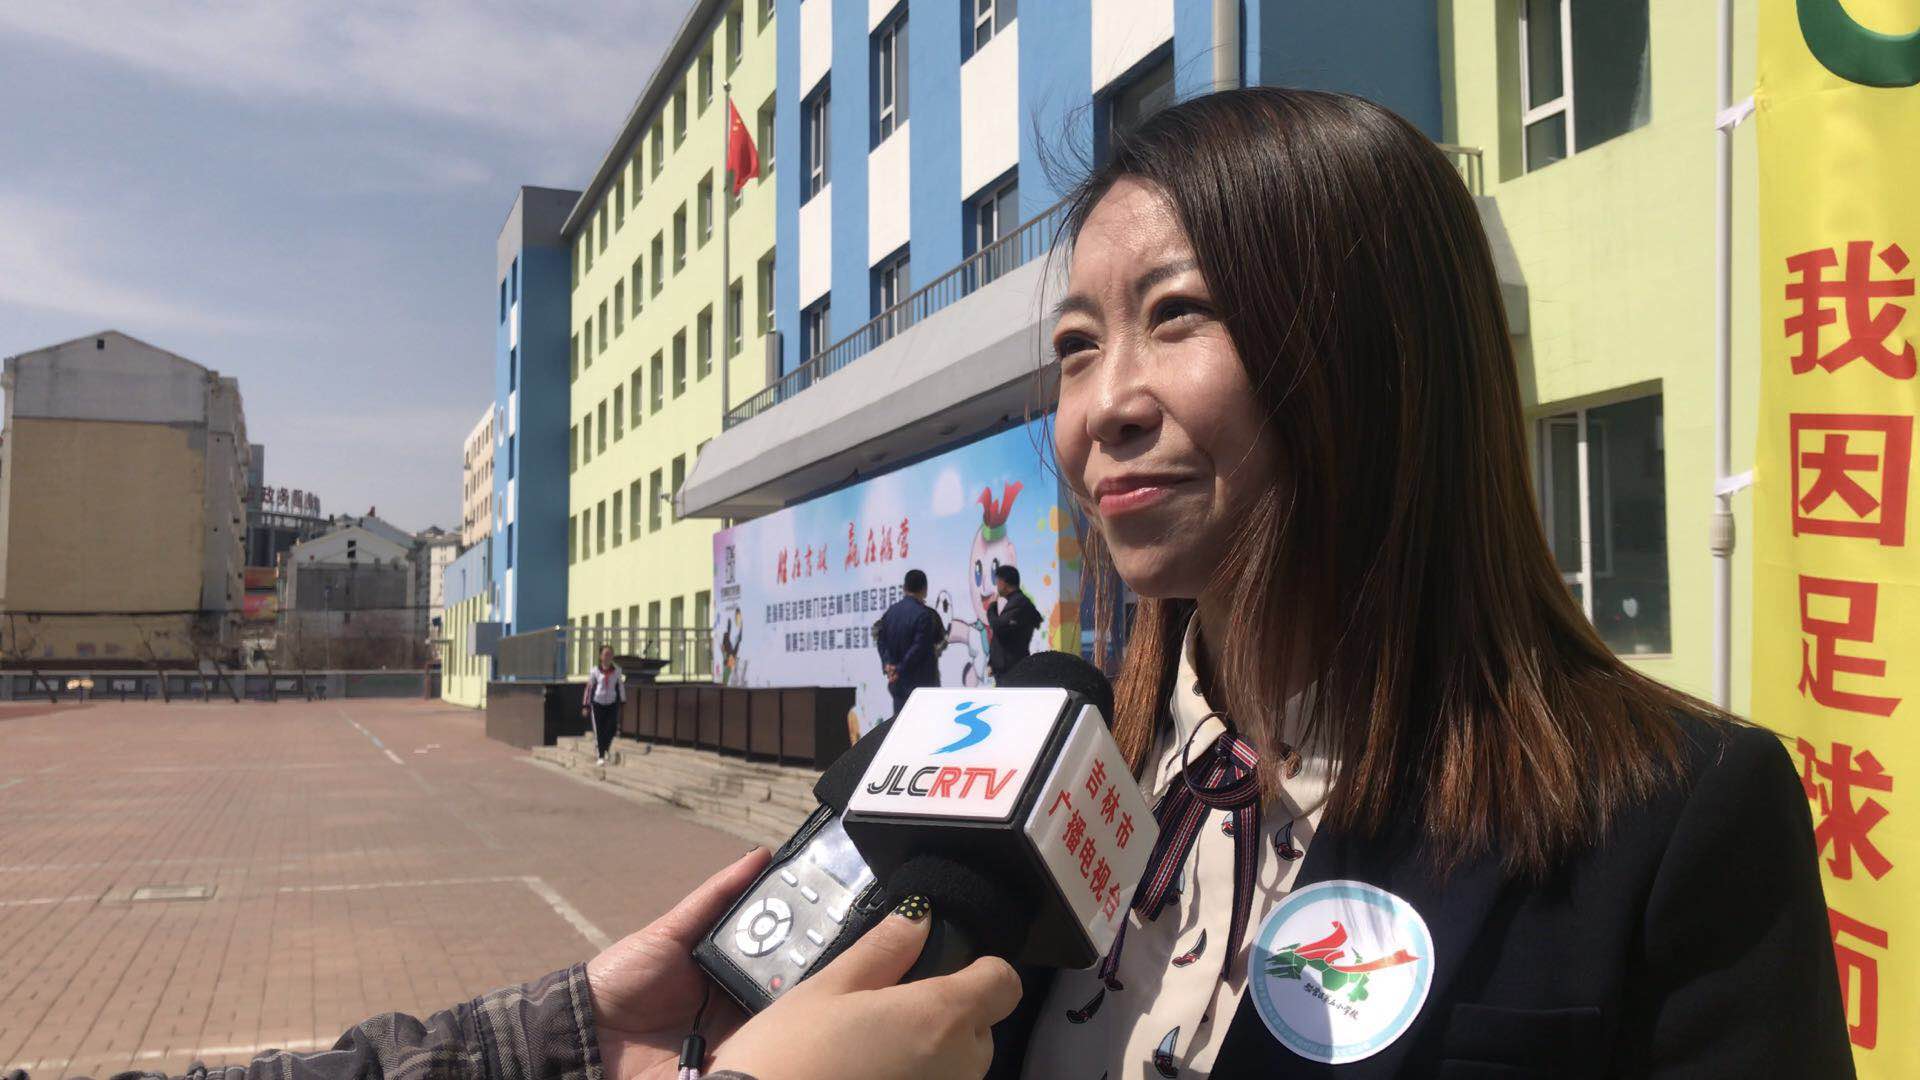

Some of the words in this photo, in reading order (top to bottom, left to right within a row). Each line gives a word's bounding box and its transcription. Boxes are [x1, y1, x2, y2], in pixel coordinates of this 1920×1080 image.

[867, 764, 1018, 801] JLCRTV
[1084, 758, 1135, 850] 吉林市
[1047, 789, 1122, 923] 广播电视台
